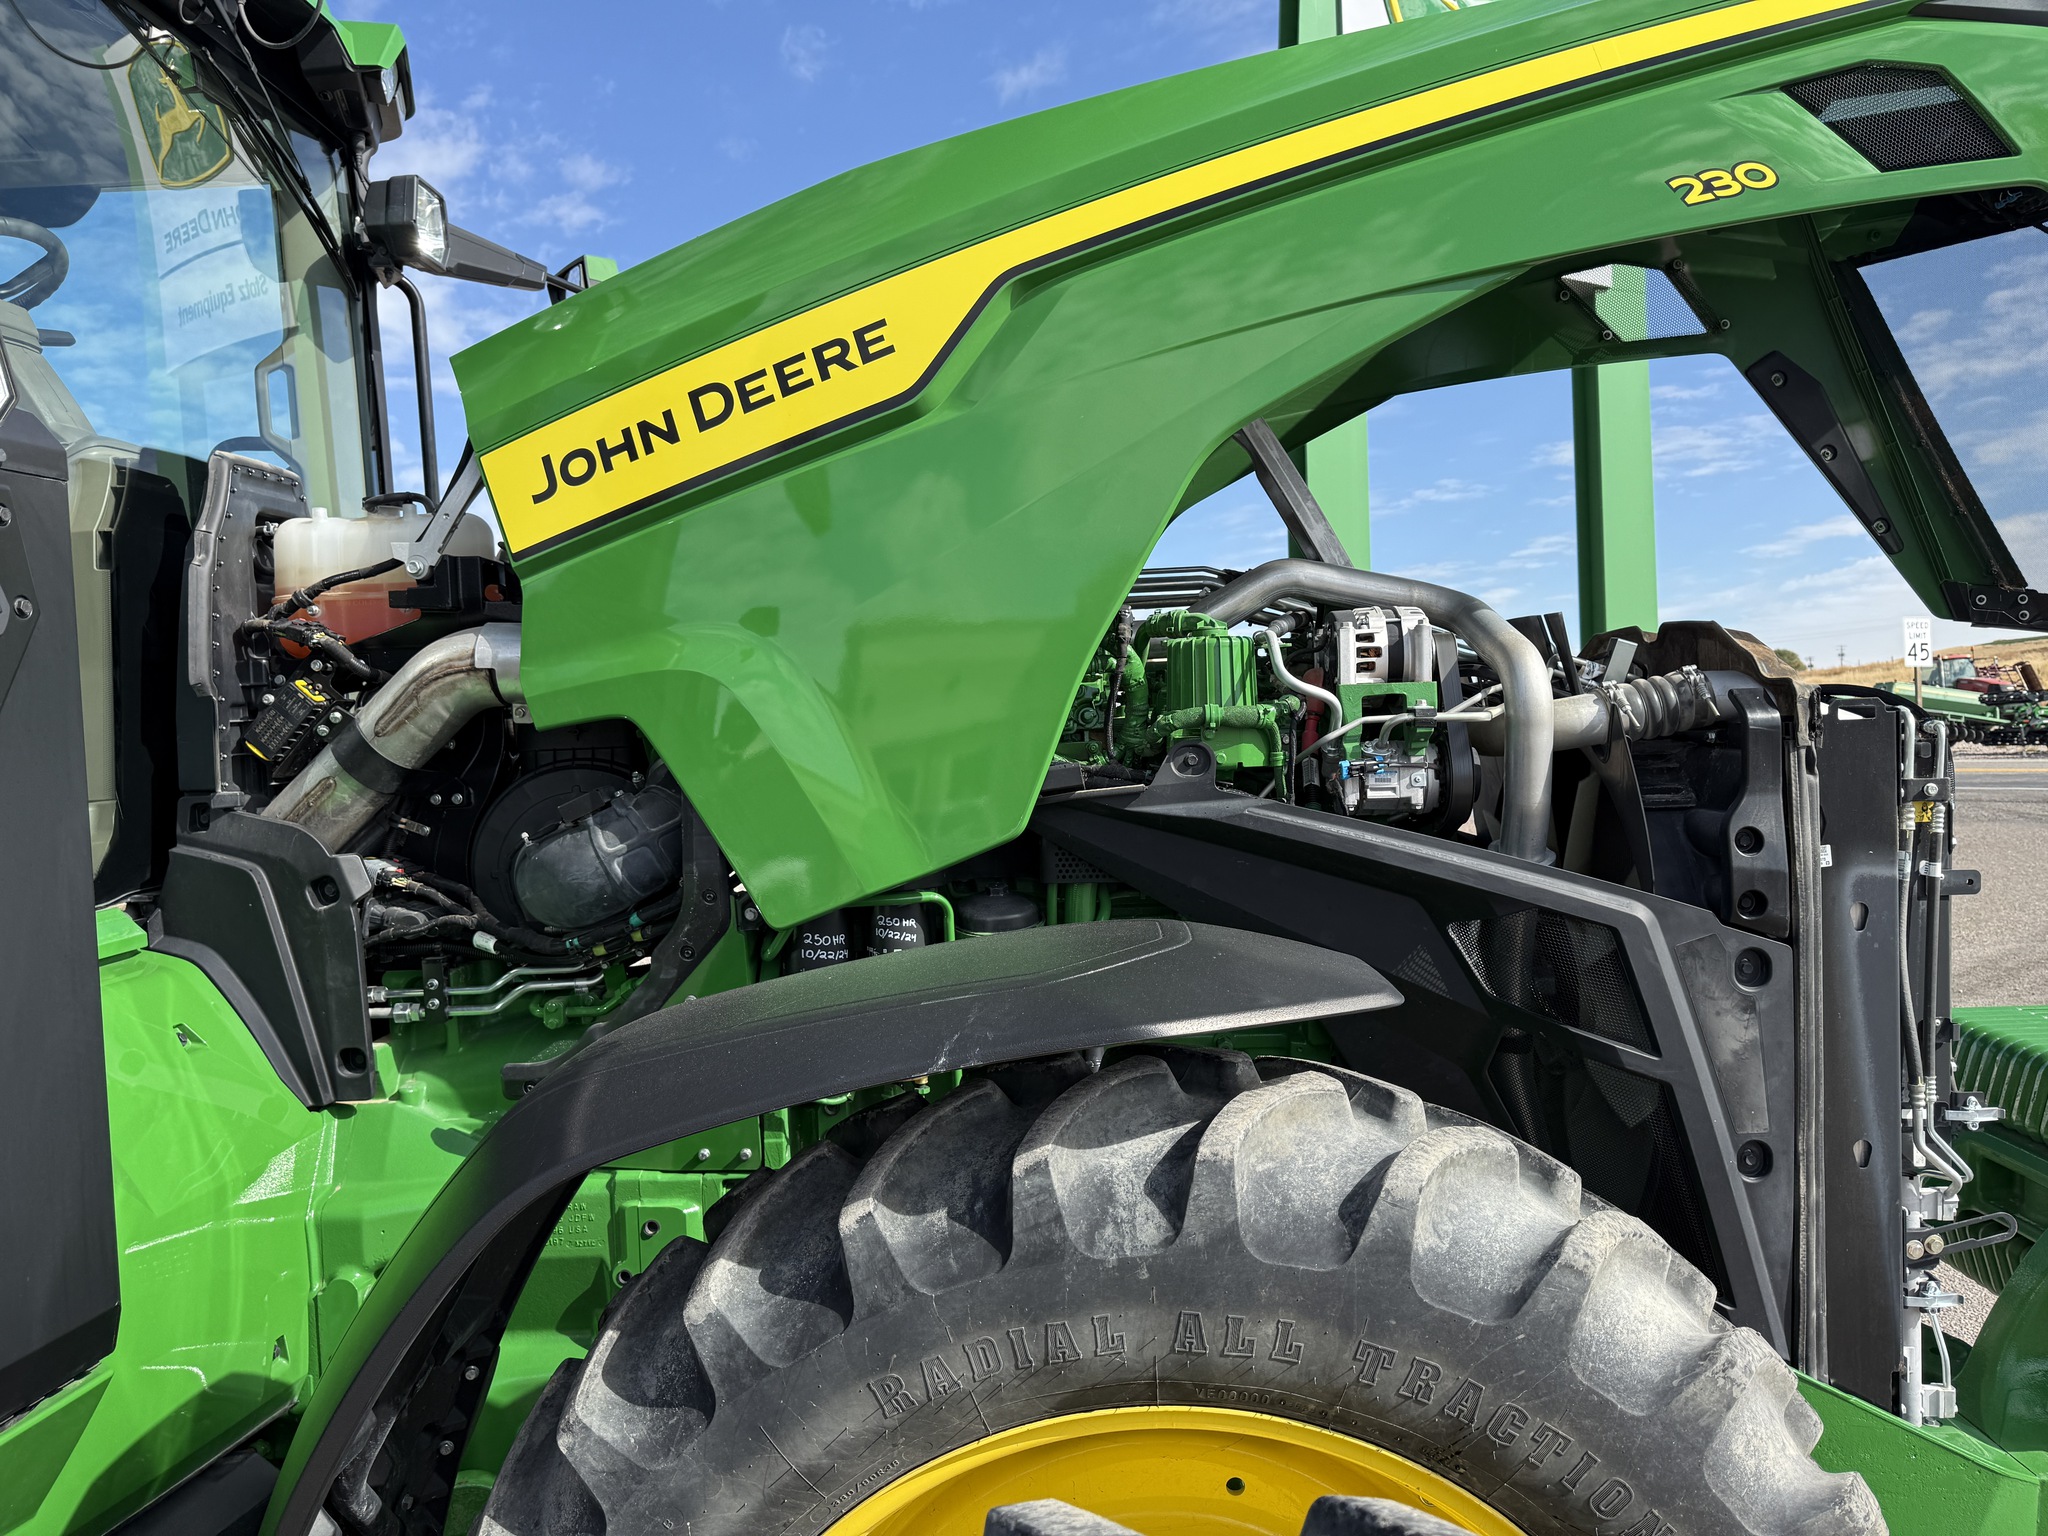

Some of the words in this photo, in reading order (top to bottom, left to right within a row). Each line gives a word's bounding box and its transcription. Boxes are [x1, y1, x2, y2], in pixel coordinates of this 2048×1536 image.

[1665, 160, 1779, 207] 230
[531, 408, 681, 505] JOHN
[687, 318, 896, 433] DEERE
[1906, 621, 1929, 630] SPEED
[1908, 632, 1927, 640] LIMIT
[1907, 642, 1930, 662] 45
[876, 915, 900, 927] 250
[902, 918, 918, 929] HR
[803, 932, 832, 946] 250
[832, 933, 846, 946] HR
[875, 927, 918, 943] 10/22/24
[801, 948, 849, 961] 10/22/24
[568, 1225, 589, 1235] USA
[867, 1313, 1129, 1419] RADIAL
[1175, 1310, 1305, 1363] ALL
